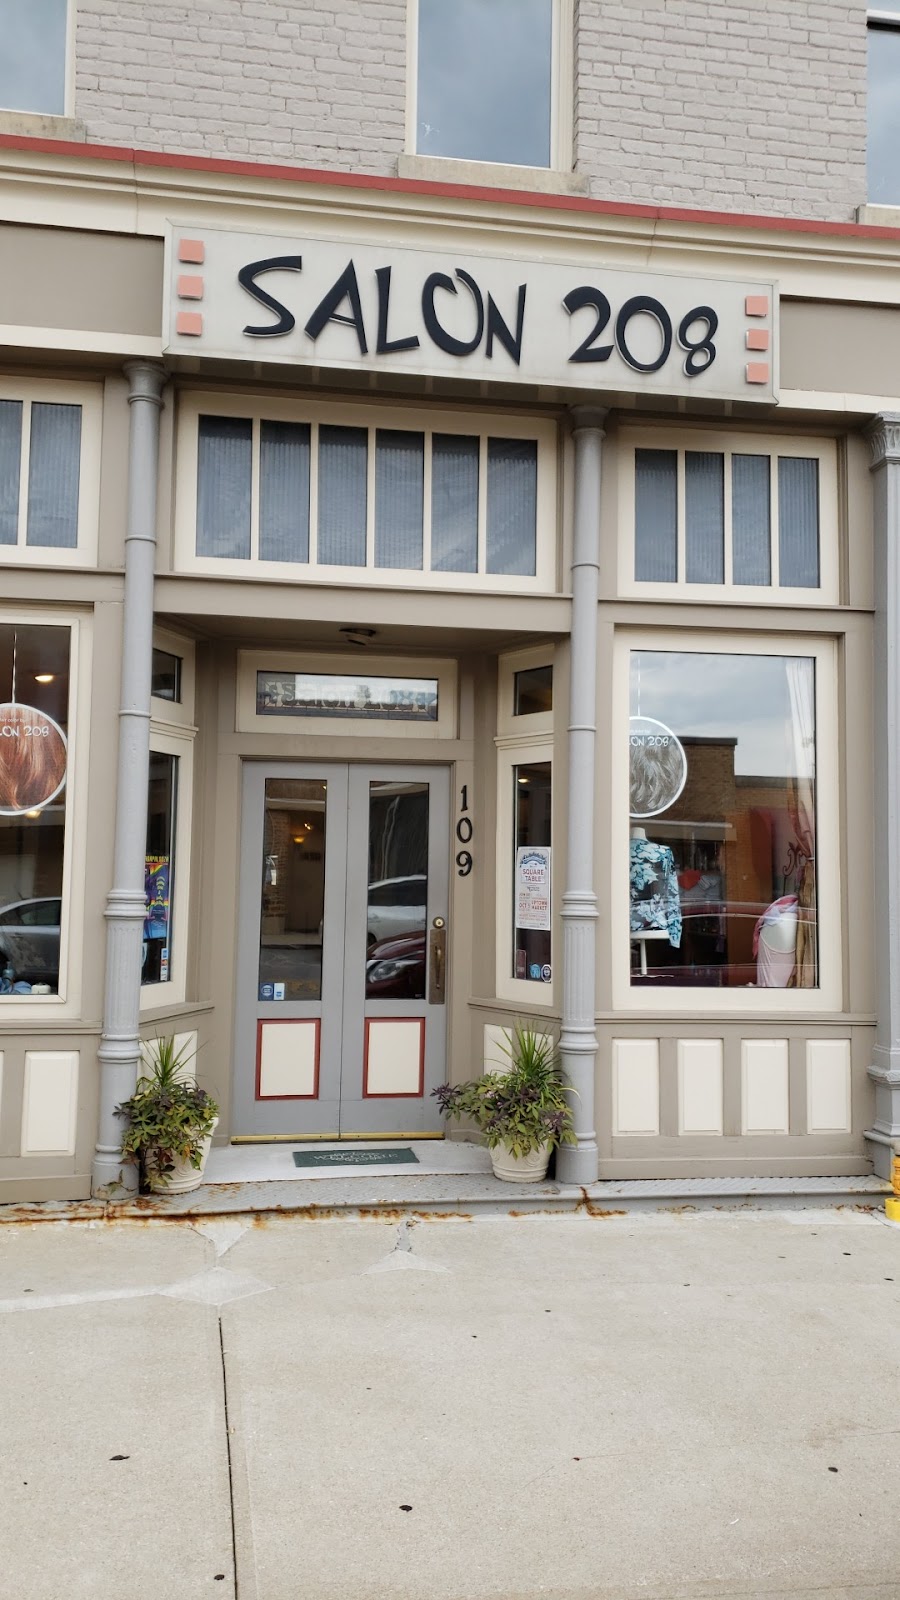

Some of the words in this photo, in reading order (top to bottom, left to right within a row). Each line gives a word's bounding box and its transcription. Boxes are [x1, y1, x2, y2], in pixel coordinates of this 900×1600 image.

[237, 255, 528, 366] SALON
[561, 286, 719, 377] 208
[23, 725, 49, 737] 208
[647, 735, 669, 747] 208
[456, 785, 473, 877] 109
[522, 868, 544, 876] SQUARE
